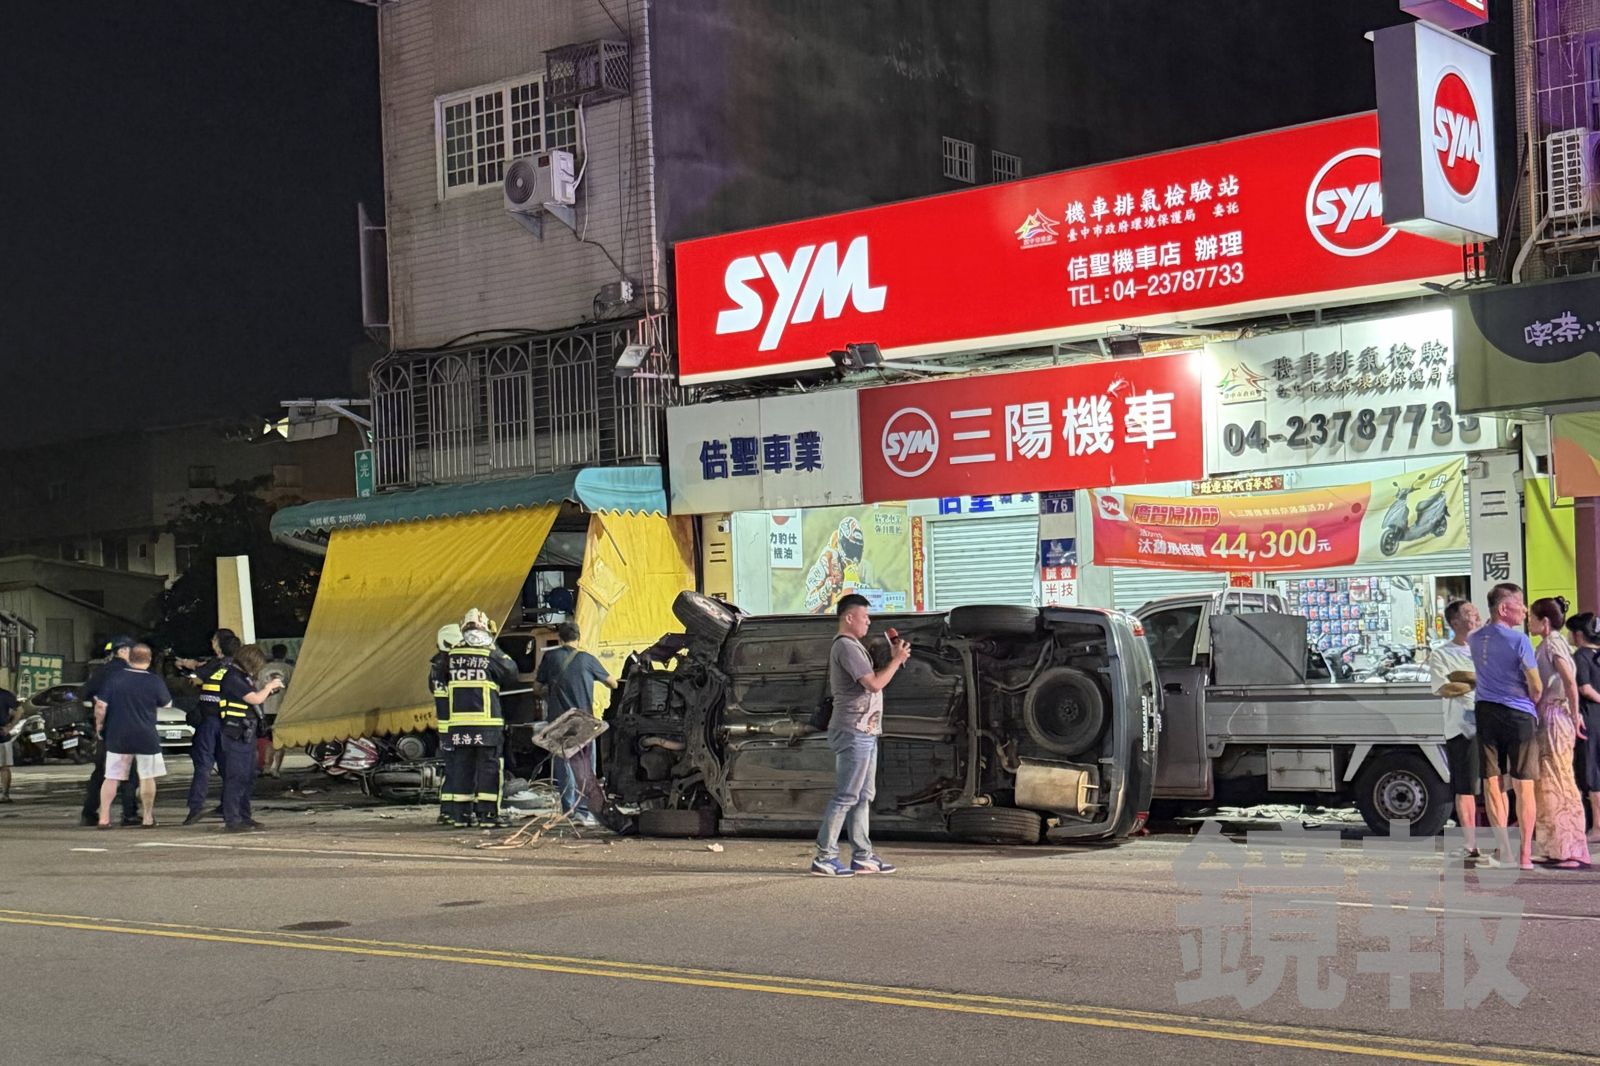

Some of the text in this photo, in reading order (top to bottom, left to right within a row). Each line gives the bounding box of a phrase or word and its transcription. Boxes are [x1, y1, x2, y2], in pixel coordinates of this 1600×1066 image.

[1433, 106, 1481, 168] SYM
[1065, 174, 1240, 225] 機車排氣檢驗站
[1067, 209, 1196, 242] 臺中市政府環境保護局
[1067, 230, 1244, 282] 佶聖機車店 辦理
[714, 235, 888, 352] SYM
[884, 430, 937, 462] SYM
[949, 389, 1177, 465] 三陽機車
[699, 430, 824, 481] 佶聖車業
[1052, 498, 1069, 513] 76
[1480, 490, 1511, 582] 三陽
[449, 668, 487, 681] TCFD
